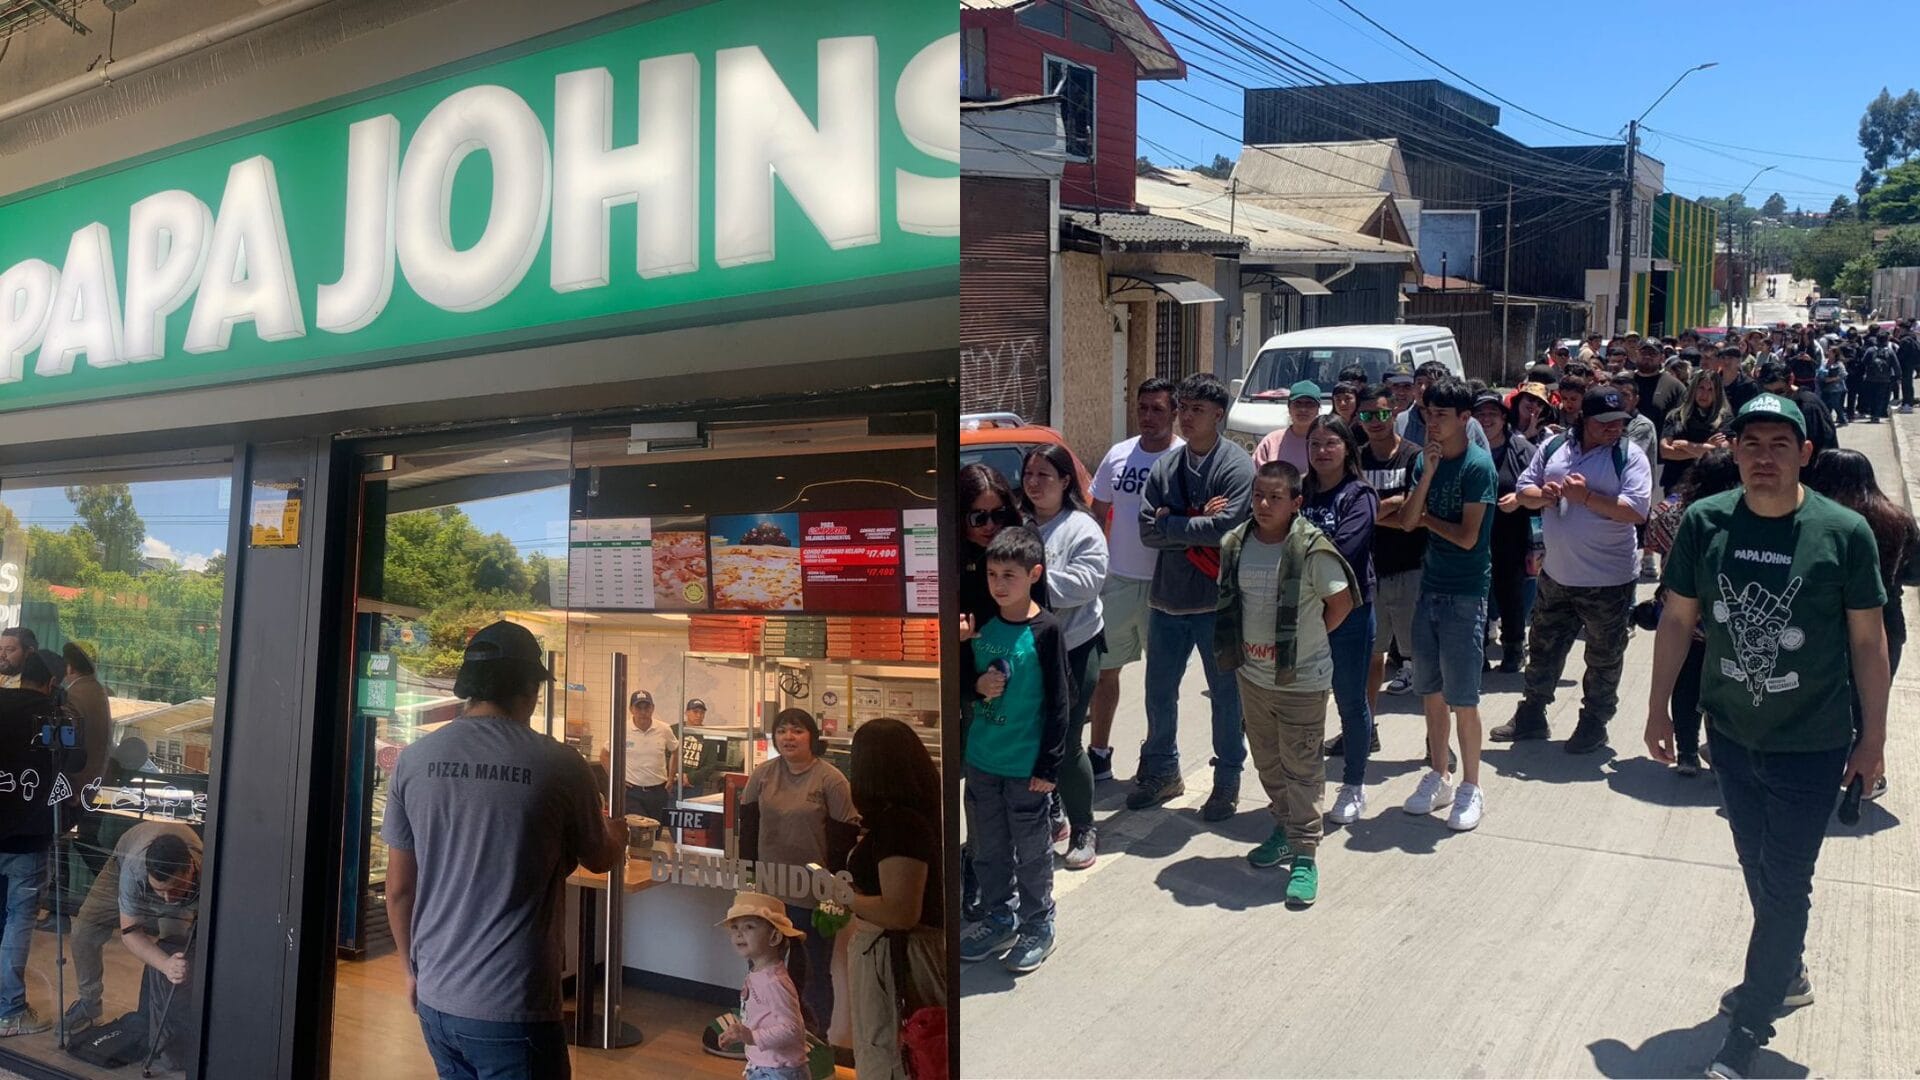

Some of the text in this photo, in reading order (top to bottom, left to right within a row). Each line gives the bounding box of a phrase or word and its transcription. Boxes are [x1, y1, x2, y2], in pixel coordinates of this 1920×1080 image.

[0, 155, 306, 384] PAPA
[1749, 396, 1781, 411] PAPA
[427, 762, 532, 784] PIZZA MAKER
[668, 810, 704, 828] TIRE
[650, 850, 855, 902] BIENVENIDOS
